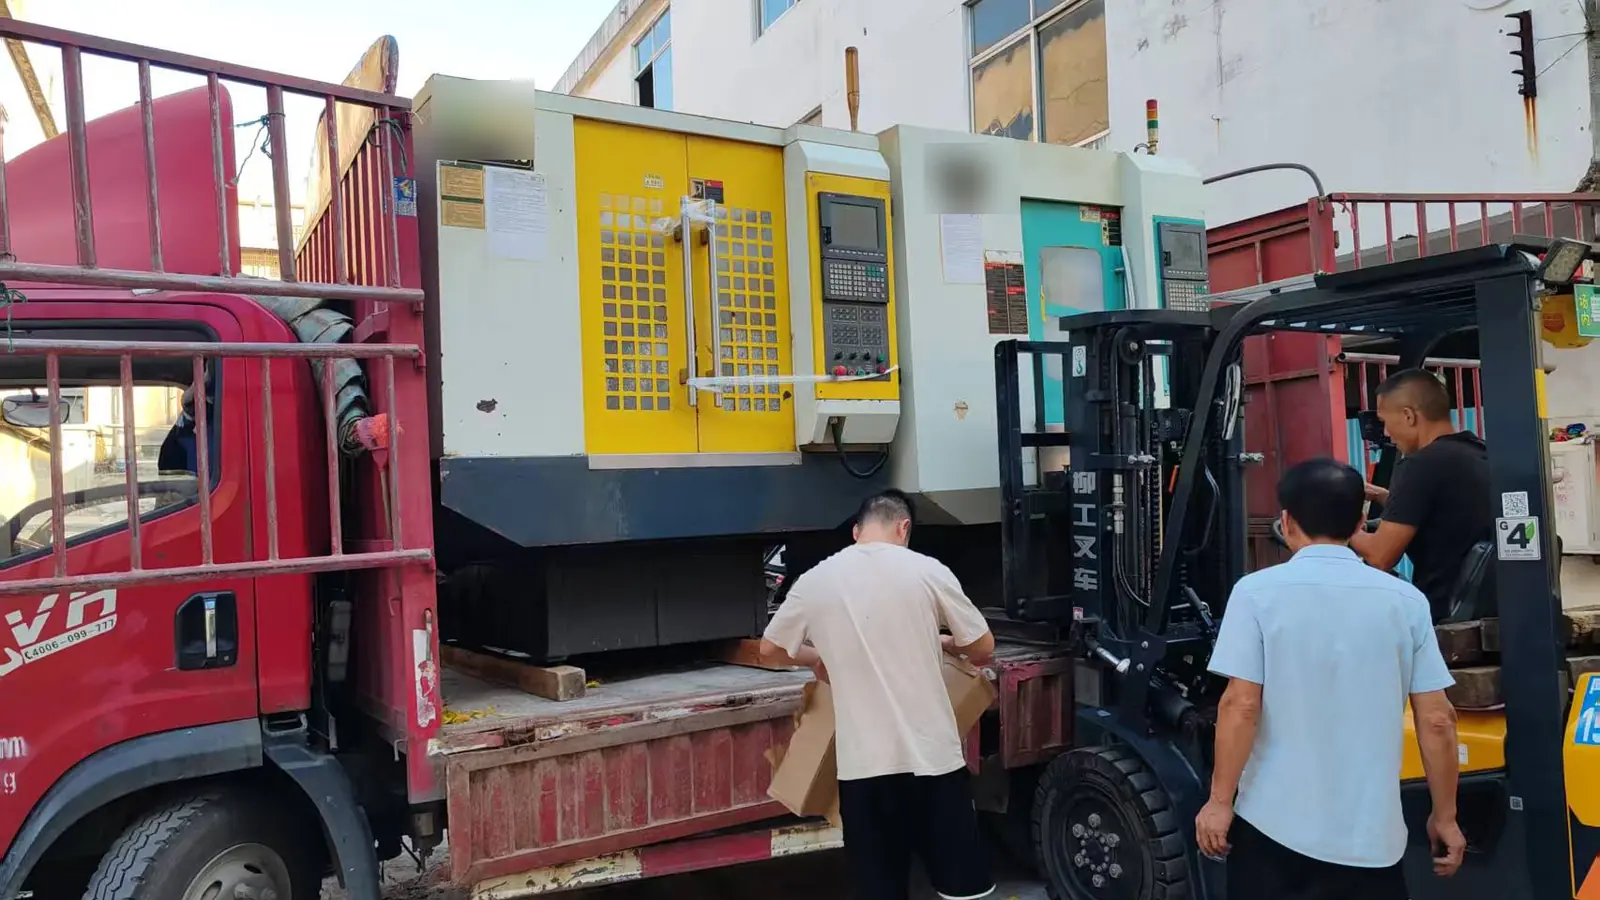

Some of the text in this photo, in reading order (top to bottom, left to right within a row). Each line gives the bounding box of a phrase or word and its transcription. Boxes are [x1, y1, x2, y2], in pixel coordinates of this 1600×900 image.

[1073, 471, 1098, 591] 柳工叉车
[1499, 521, 1509, 531] G
[1507, 523, 1530, 549] 4
[32, 619, 114, 656] 4006-099-777
